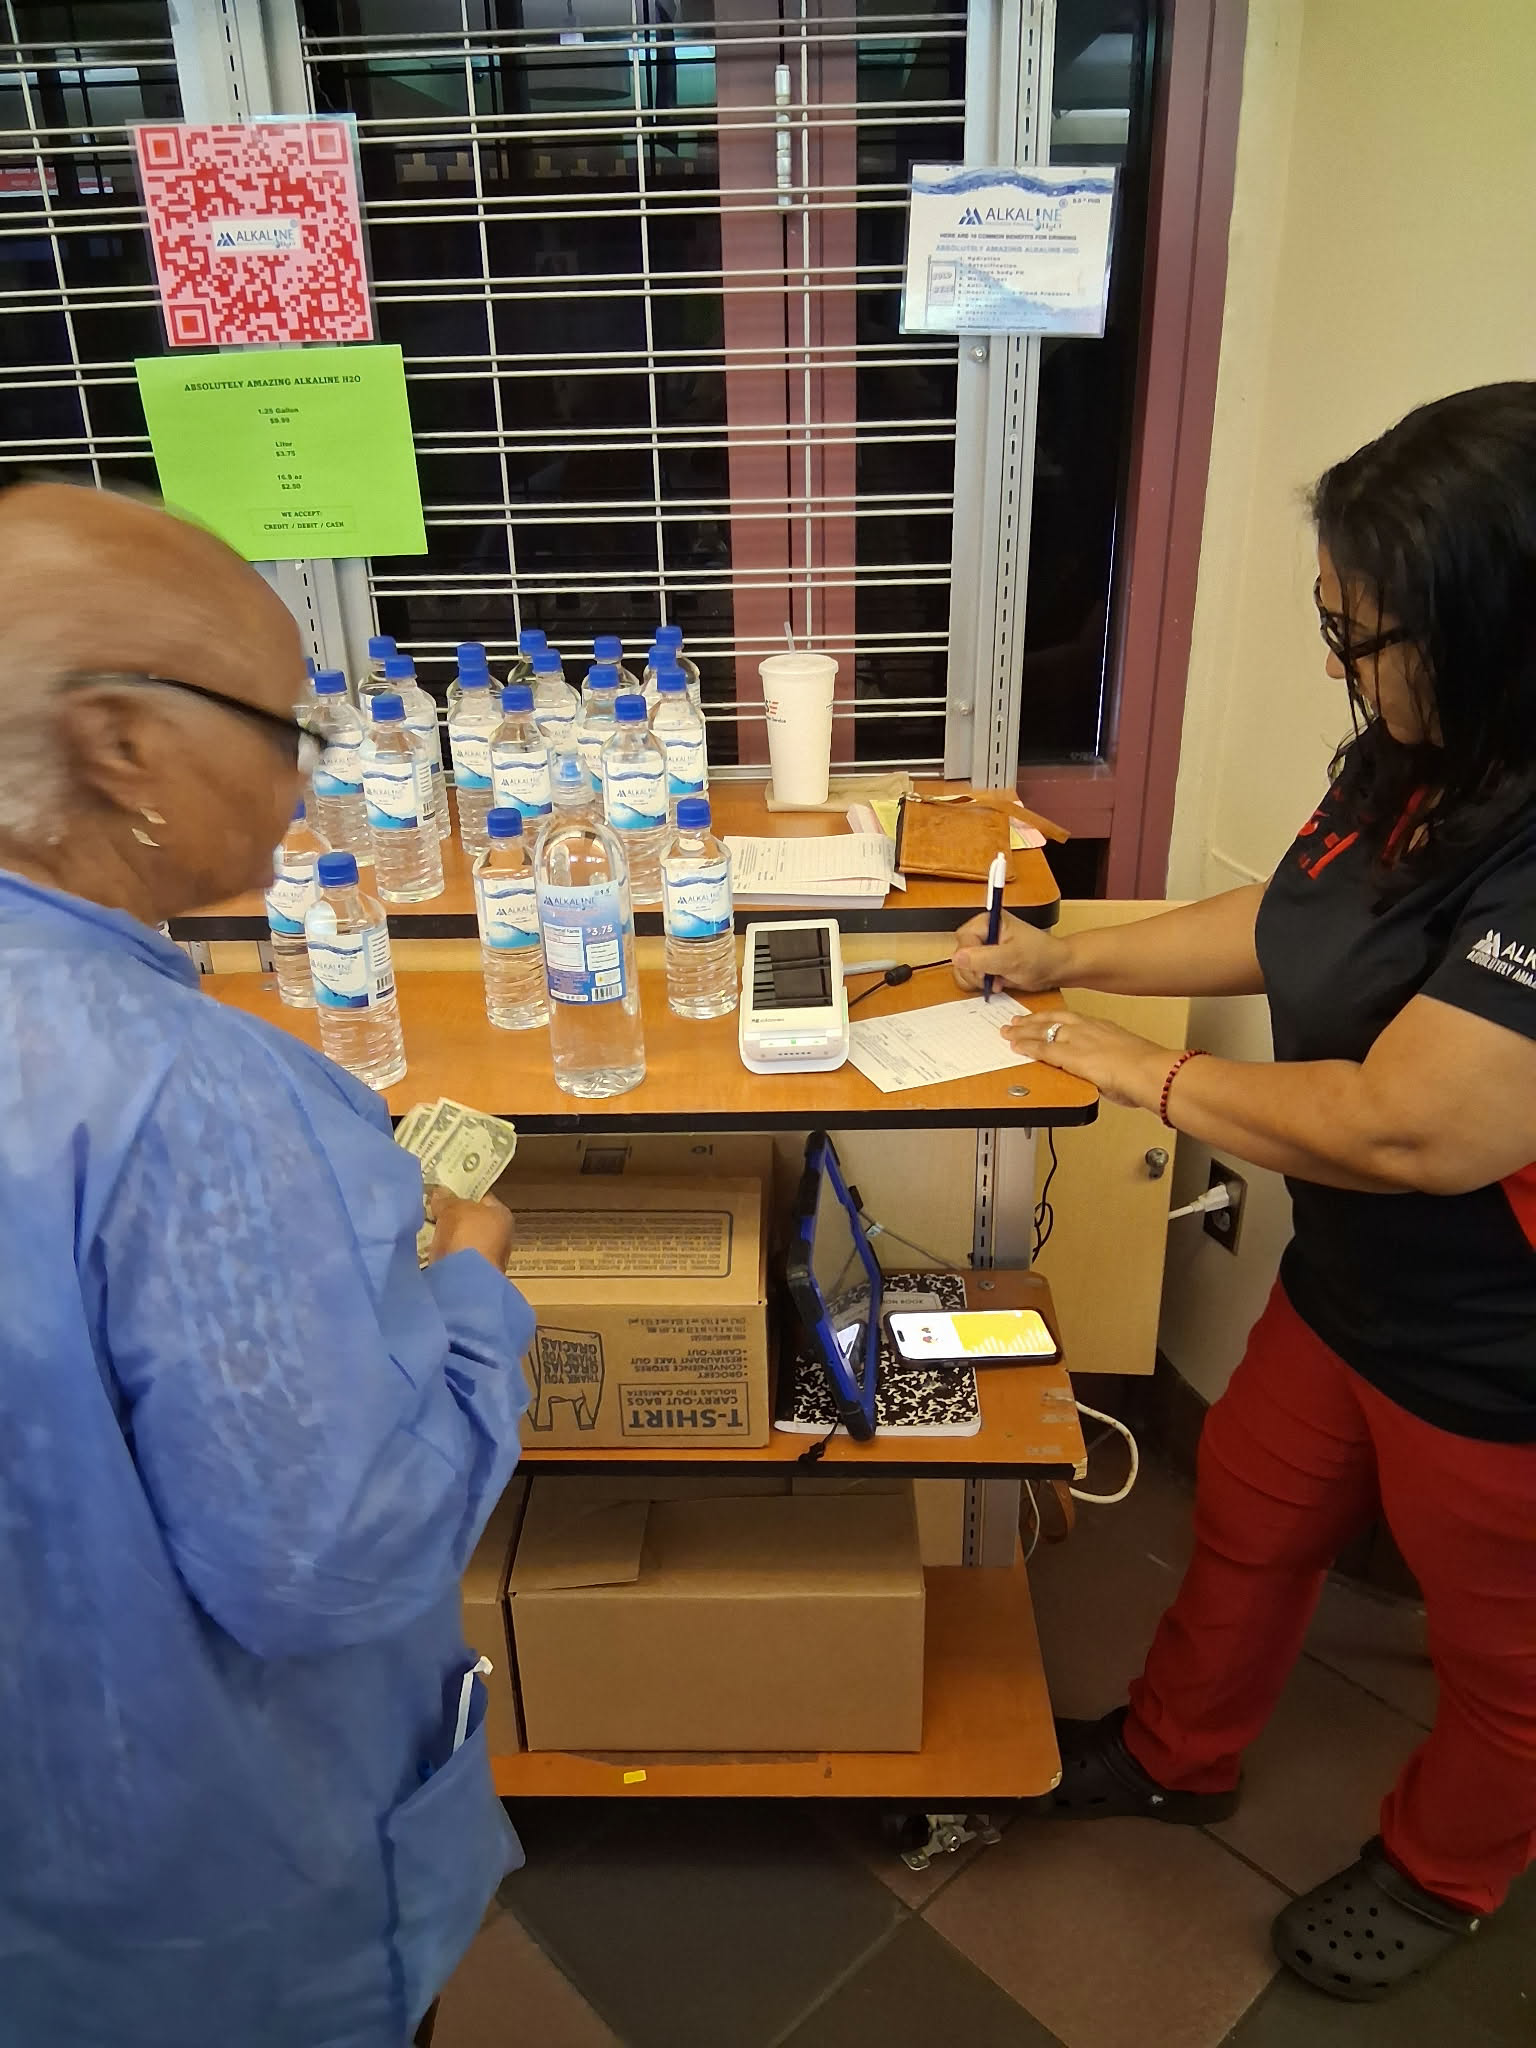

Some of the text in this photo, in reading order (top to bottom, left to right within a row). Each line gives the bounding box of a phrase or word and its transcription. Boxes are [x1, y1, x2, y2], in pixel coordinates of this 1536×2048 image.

[985, 207, 1062, 222] ALKALINE
[236, 229, 294, 243] ALKALINE
[184, 375, 361, 392] ABSOLUTELY AMAZING ALKALINE H2O
[541, 1337, 597, 1354] GRACIAS
[687, 1348, 742, 1356] CARRY-OUT
[543, 1352, 563, 1363] YOU
[654, 1357, 677, 1365] TAKE
[680, 1356, 742, 1364] RESTAURANT
[543, 1361, 599, 1374] GRACIAS
[673, 1363, 742, 1371] CONVENIENCE
[544, 1375, 600, 1385] THANK YOU
[697, 1371, 743, 1379] GROCERY
[627, 1396, 738, 1406] CARRY-OUT BAGS
[629, 1409, 743, 1428] T-SHIRT
